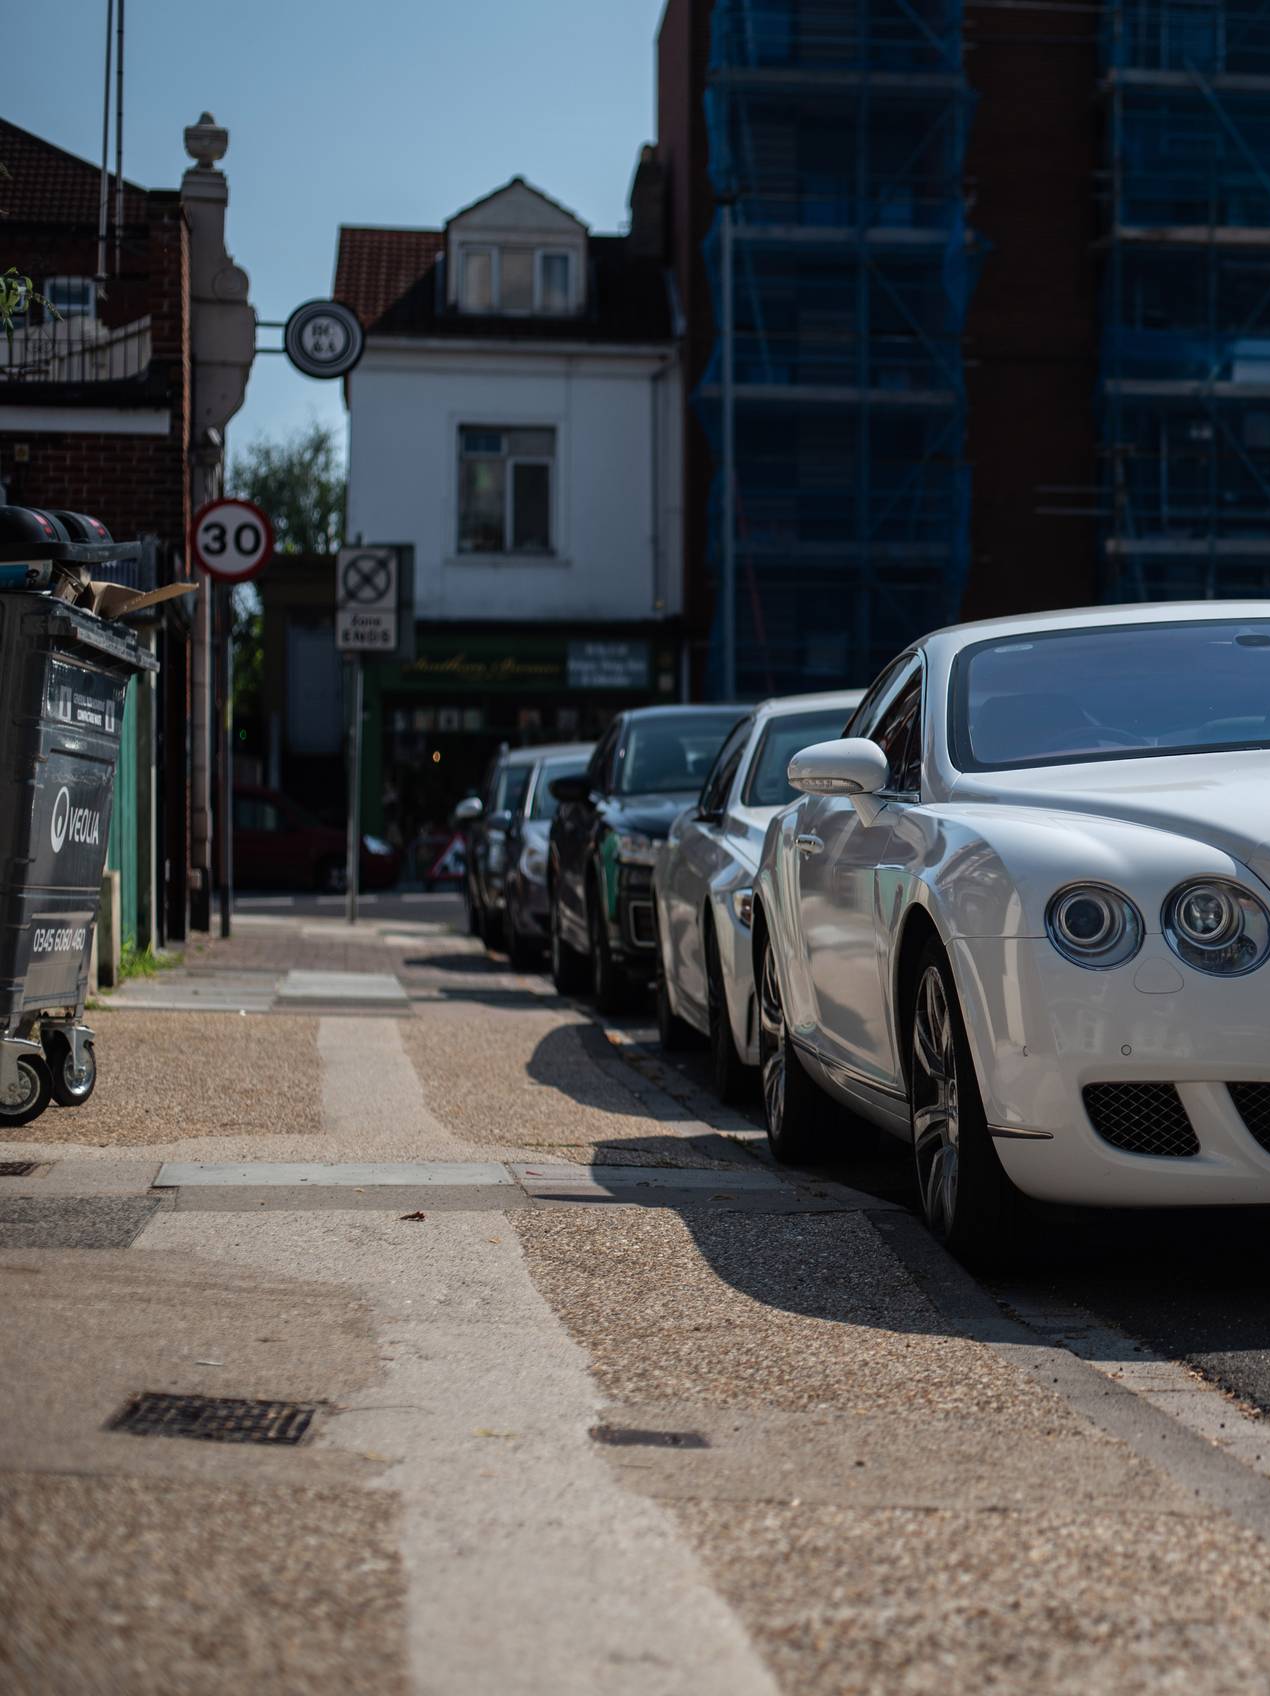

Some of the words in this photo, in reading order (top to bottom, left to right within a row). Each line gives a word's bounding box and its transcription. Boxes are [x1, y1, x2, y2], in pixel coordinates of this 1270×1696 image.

[202, 522, 261, 555] 30
[342, 628, 391, 643] ENDS
[69, 806, 100, 846] VEOLIA
[33, 928, 55, 952] 0345
[54, 928, 73, 952] 6060
[72, 928, 87, 951] 460
